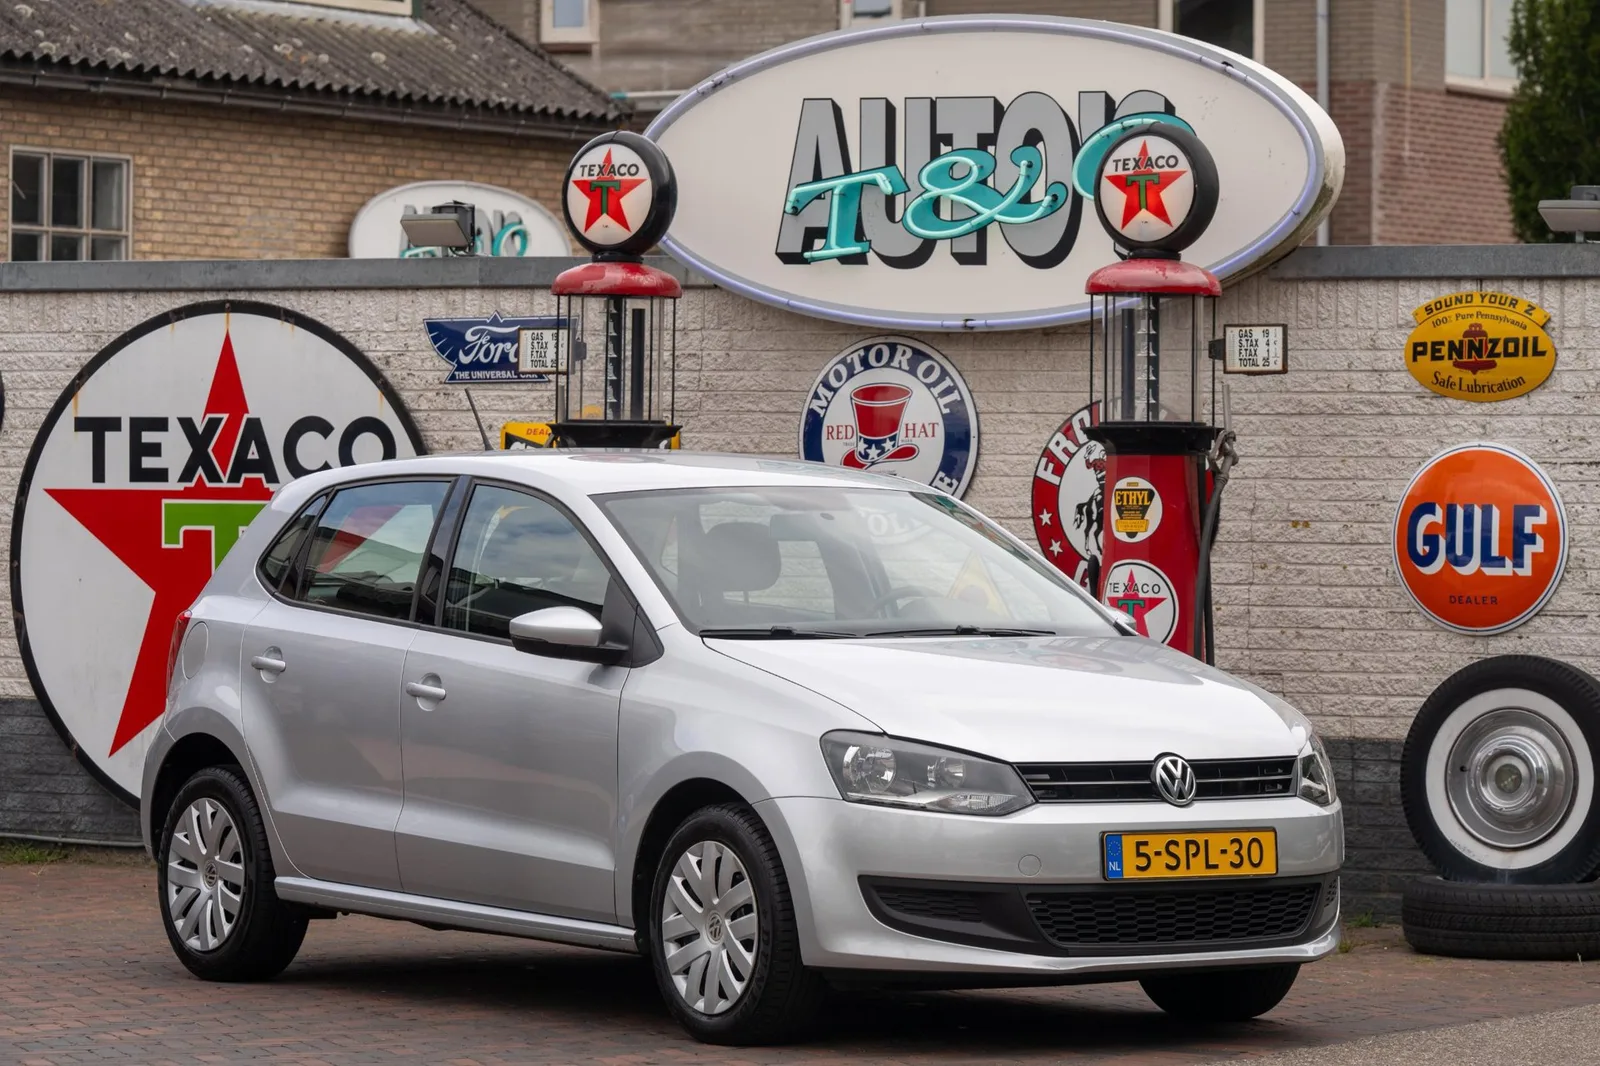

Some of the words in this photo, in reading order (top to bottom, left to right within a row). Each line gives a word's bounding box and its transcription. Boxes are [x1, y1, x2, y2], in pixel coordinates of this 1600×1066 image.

[579, 163, 640, 178] TEXACO
[1112, 154, 1180, 172] TEXACO
[1424, 293, 1474, 316] SOUND
[1479, 293, 1519, 309] YOUR
[1523, 304, 1537, 316] Z
[1455, 312, 1475, 322] Pure
[1475, 310, 1528, 331] Pennsylvania
[530, 332, 544, 341] GAS
[1238, 329, 1253, 338] GAS
[1262, 329, 1269, 338] 19
[530, 341, 549, 350] S.TAX
[1238, 338, 1259, 348] S.TAX
[1265, 339, 1269, 347] 4
[1412, 336, 1548, 363] PENNZOIL
[530, 350, 548, 359] F.TAX
[1238, 348, 1258, 358] F.TAX
[530, 359, 549, 368] TOTAL
[1238, 358, 1260, 367] TOTAL
[1262, 358, 1269, 367] 25
[454, 371, 470, 379] THE
[472, 370, 518, 379] UNIVERSAL
[810, 343, 914, 418] MOTOR
[916, 359, 962, 415] OIL
[1431, 370, 1457, 391] Safe
[1458, 375, 1526, 394] Lubrication
[826, 424, 855, 440] RED
[904, 422, 939, 439] HAT
[74, 414, 397, 485] TEXACO
[1115, 490, 1151, 506] ETHYL
[1407, 501, 1548, 576] GULF
[1449, 594, 1498, 606] DEALER
[1135, 837, 1264, 872] 5-SPL-30
[1108, 861, 1121, 872] NL
